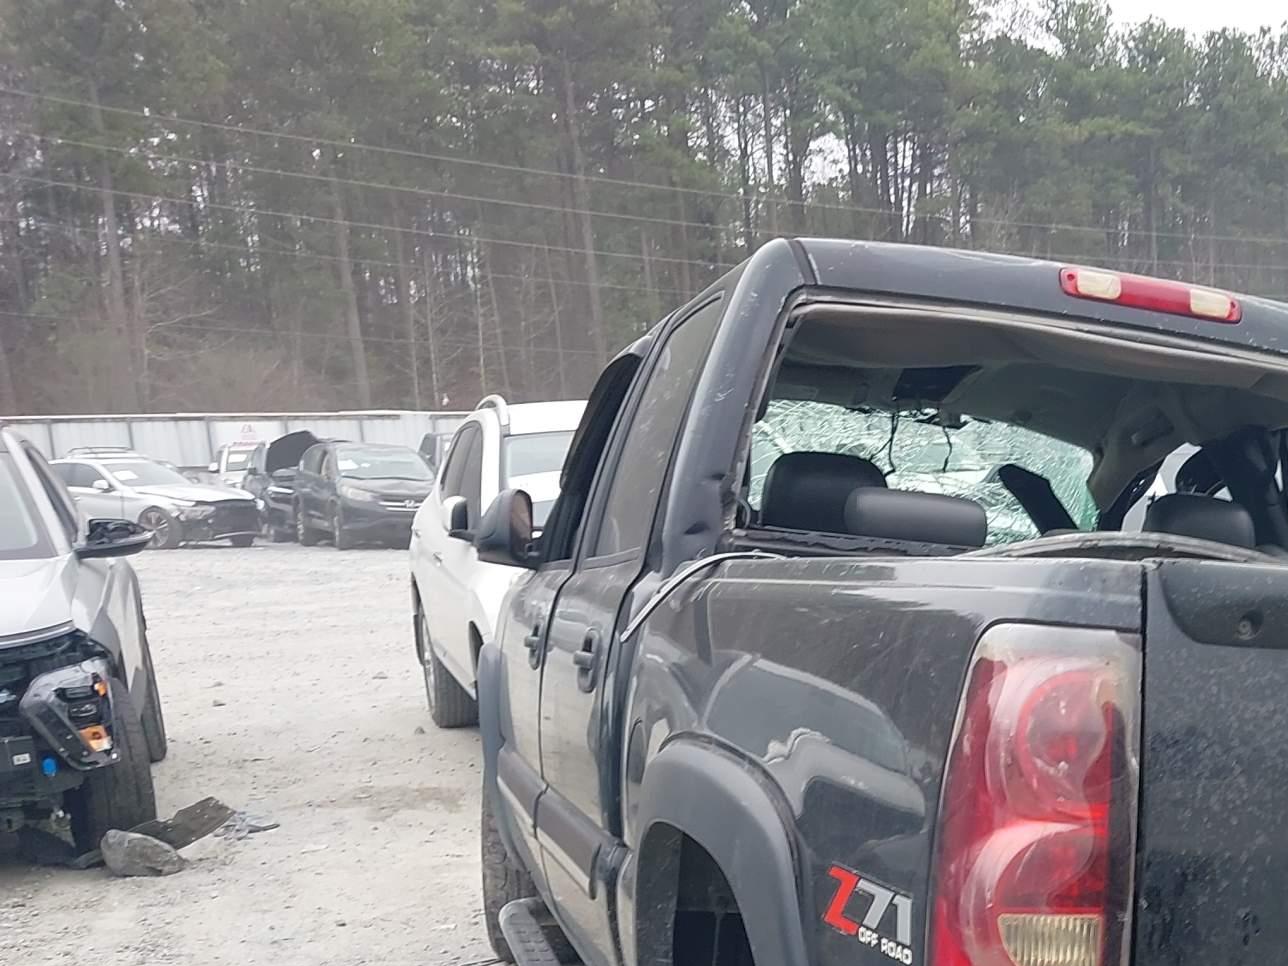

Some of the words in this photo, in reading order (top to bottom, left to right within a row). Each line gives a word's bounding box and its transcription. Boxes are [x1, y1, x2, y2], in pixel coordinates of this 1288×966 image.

[824, 866, 912, 946] Z71
[858, 927, 878, 948] OFF
[880, 938, 912, 965] ROAD
